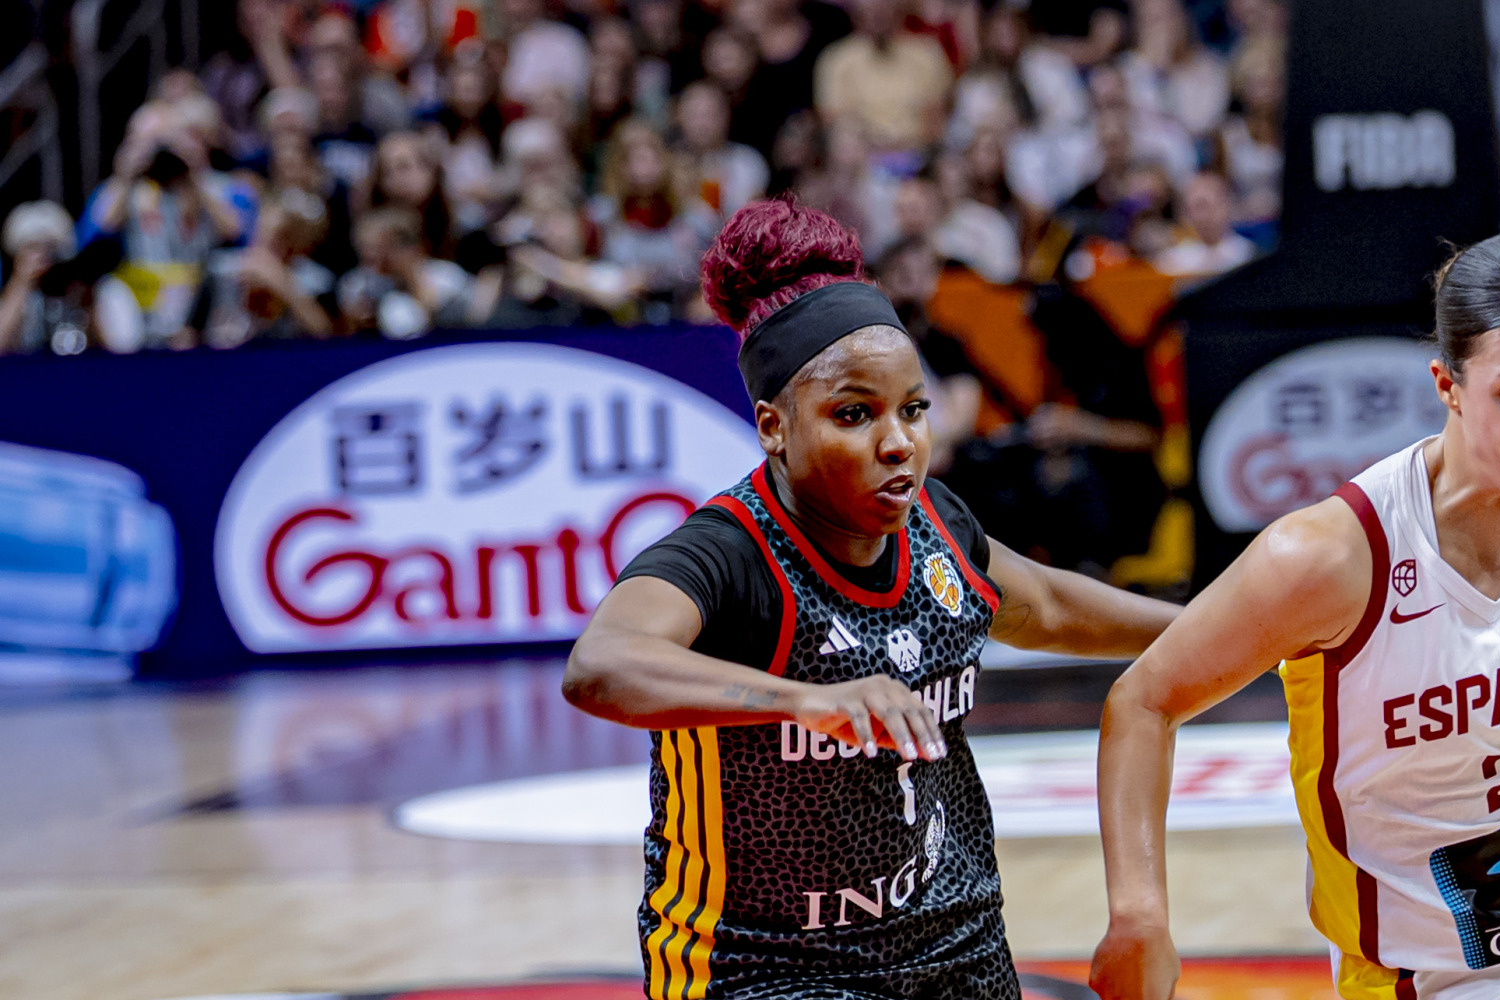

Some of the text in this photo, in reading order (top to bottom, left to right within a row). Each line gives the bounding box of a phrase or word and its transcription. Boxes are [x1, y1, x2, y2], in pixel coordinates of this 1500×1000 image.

[332, 390, 671, 494] 百岁山
[801, 855, 918, 930] ING
